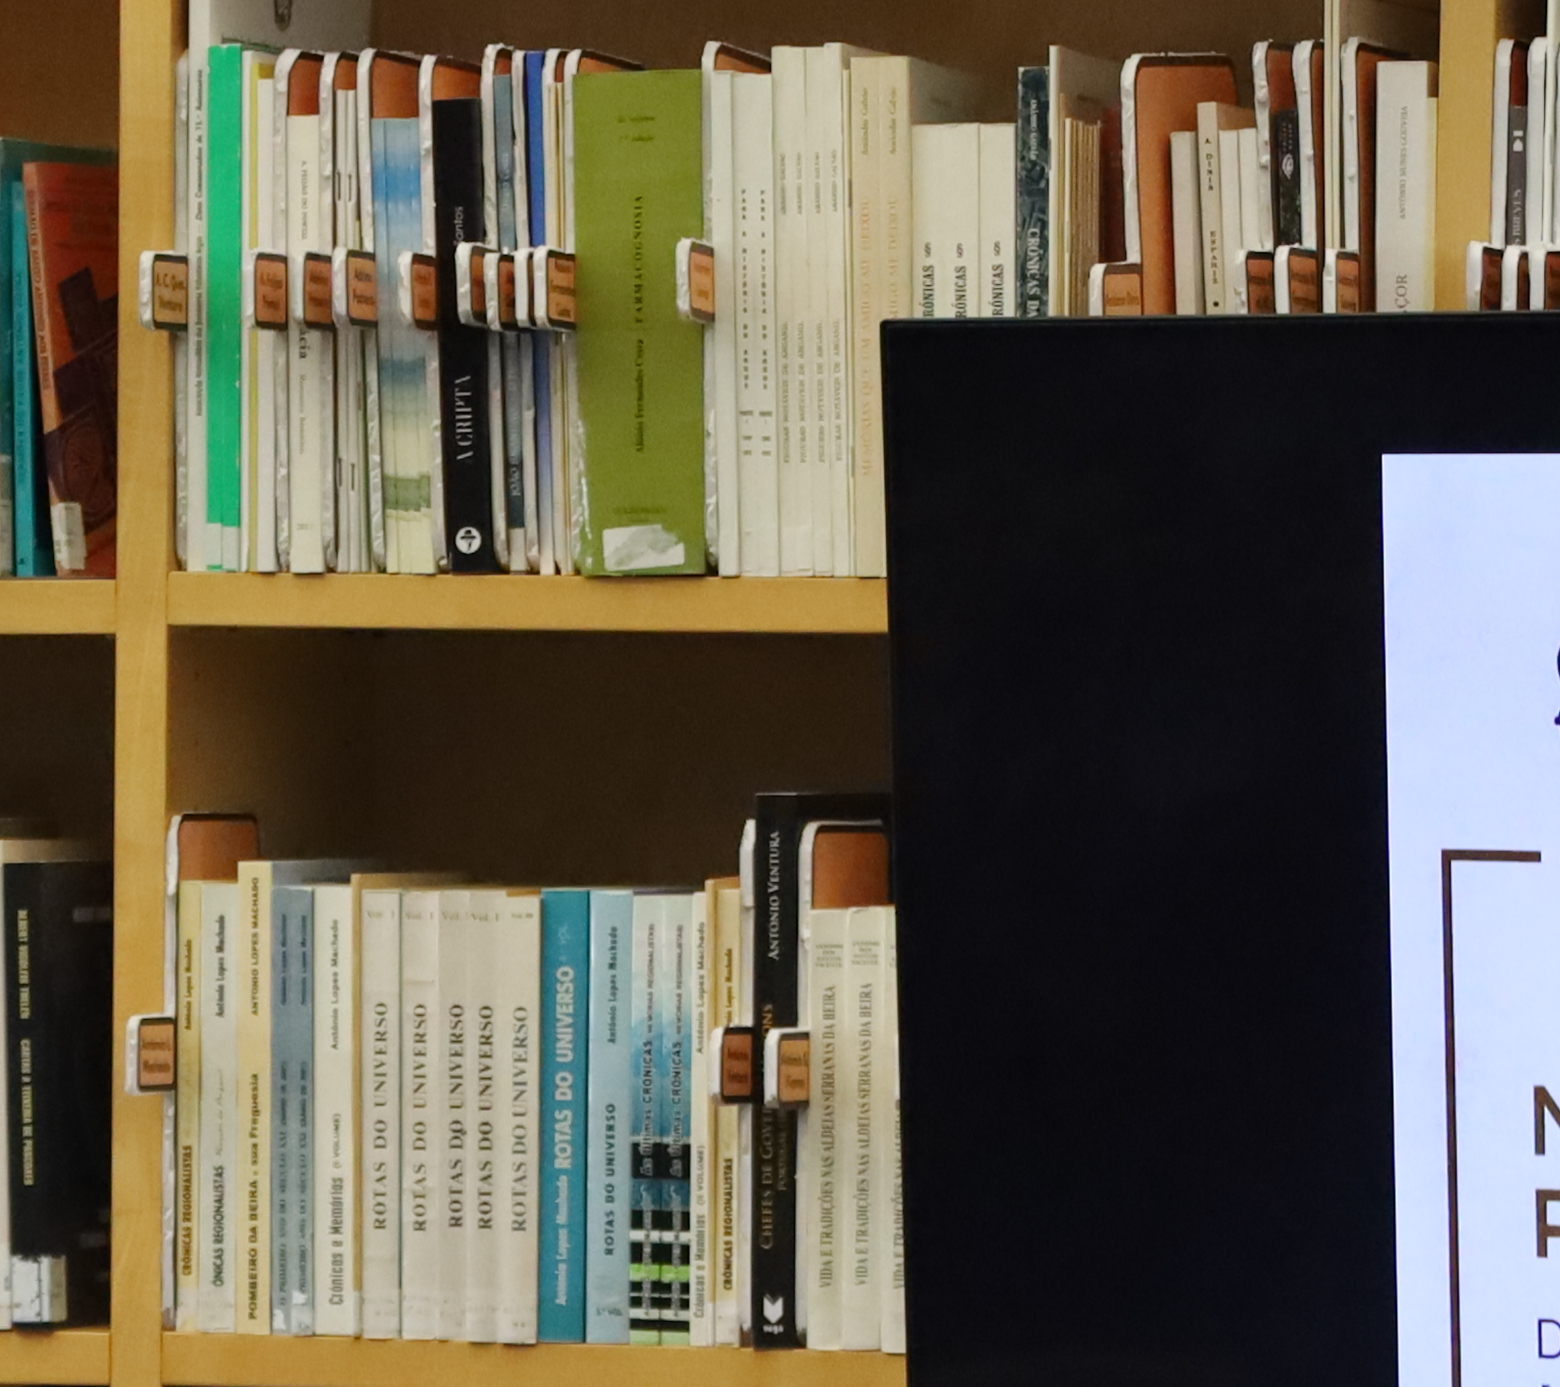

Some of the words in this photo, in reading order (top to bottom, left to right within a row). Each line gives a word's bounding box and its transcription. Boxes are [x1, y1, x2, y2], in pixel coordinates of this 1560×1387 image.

[478, 1005, 494, 1112] UNIVERSO
[478, 1121, 493, 1151] DO
[478, 1160, 493, 1230] ROTAS
